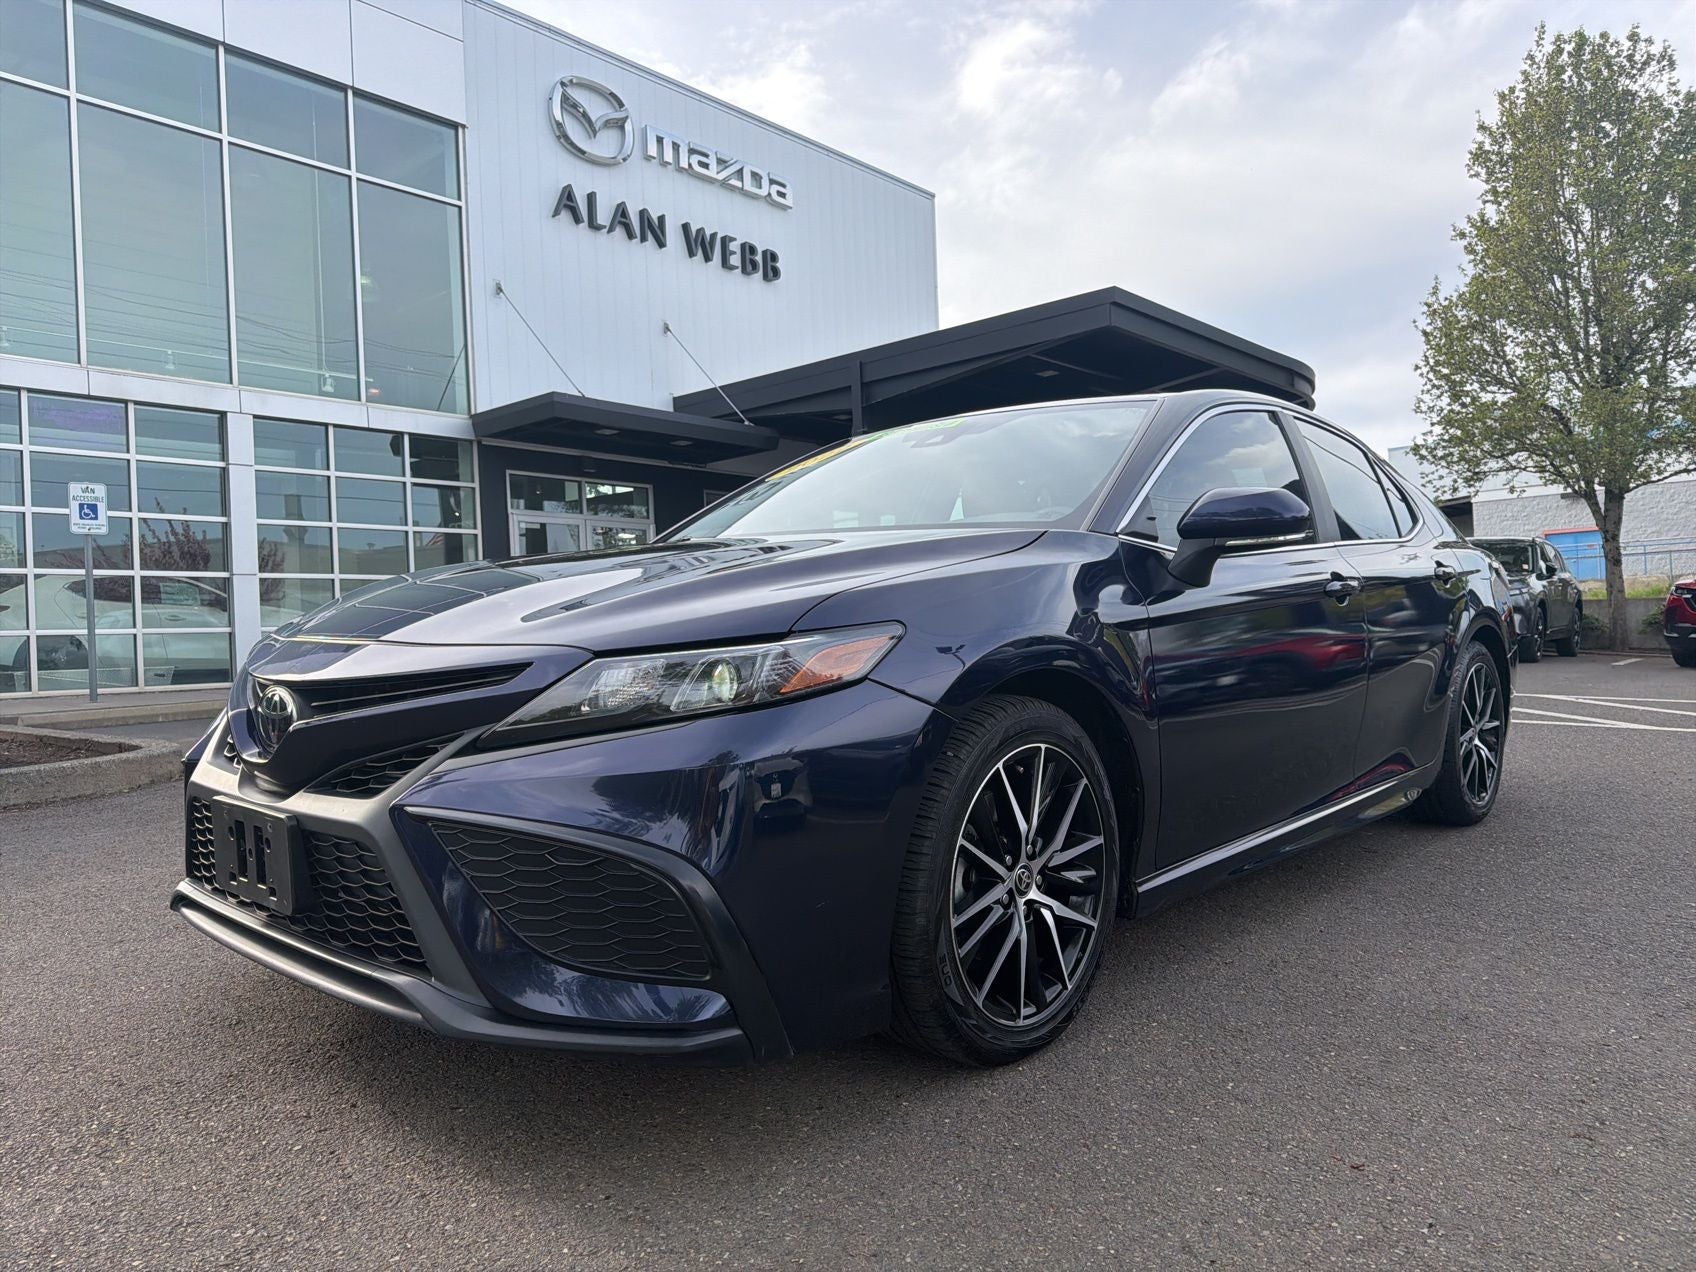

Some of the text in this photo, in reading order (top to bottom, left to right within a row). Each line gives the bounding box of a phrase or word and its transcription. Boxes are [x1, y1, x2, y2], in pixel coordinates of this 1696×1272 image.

[551, 183, 782, 282] ALAN WEBB
[81, 486, 95, 494] VAN
[72, 494, 105, 503] ACCESSIBLE
